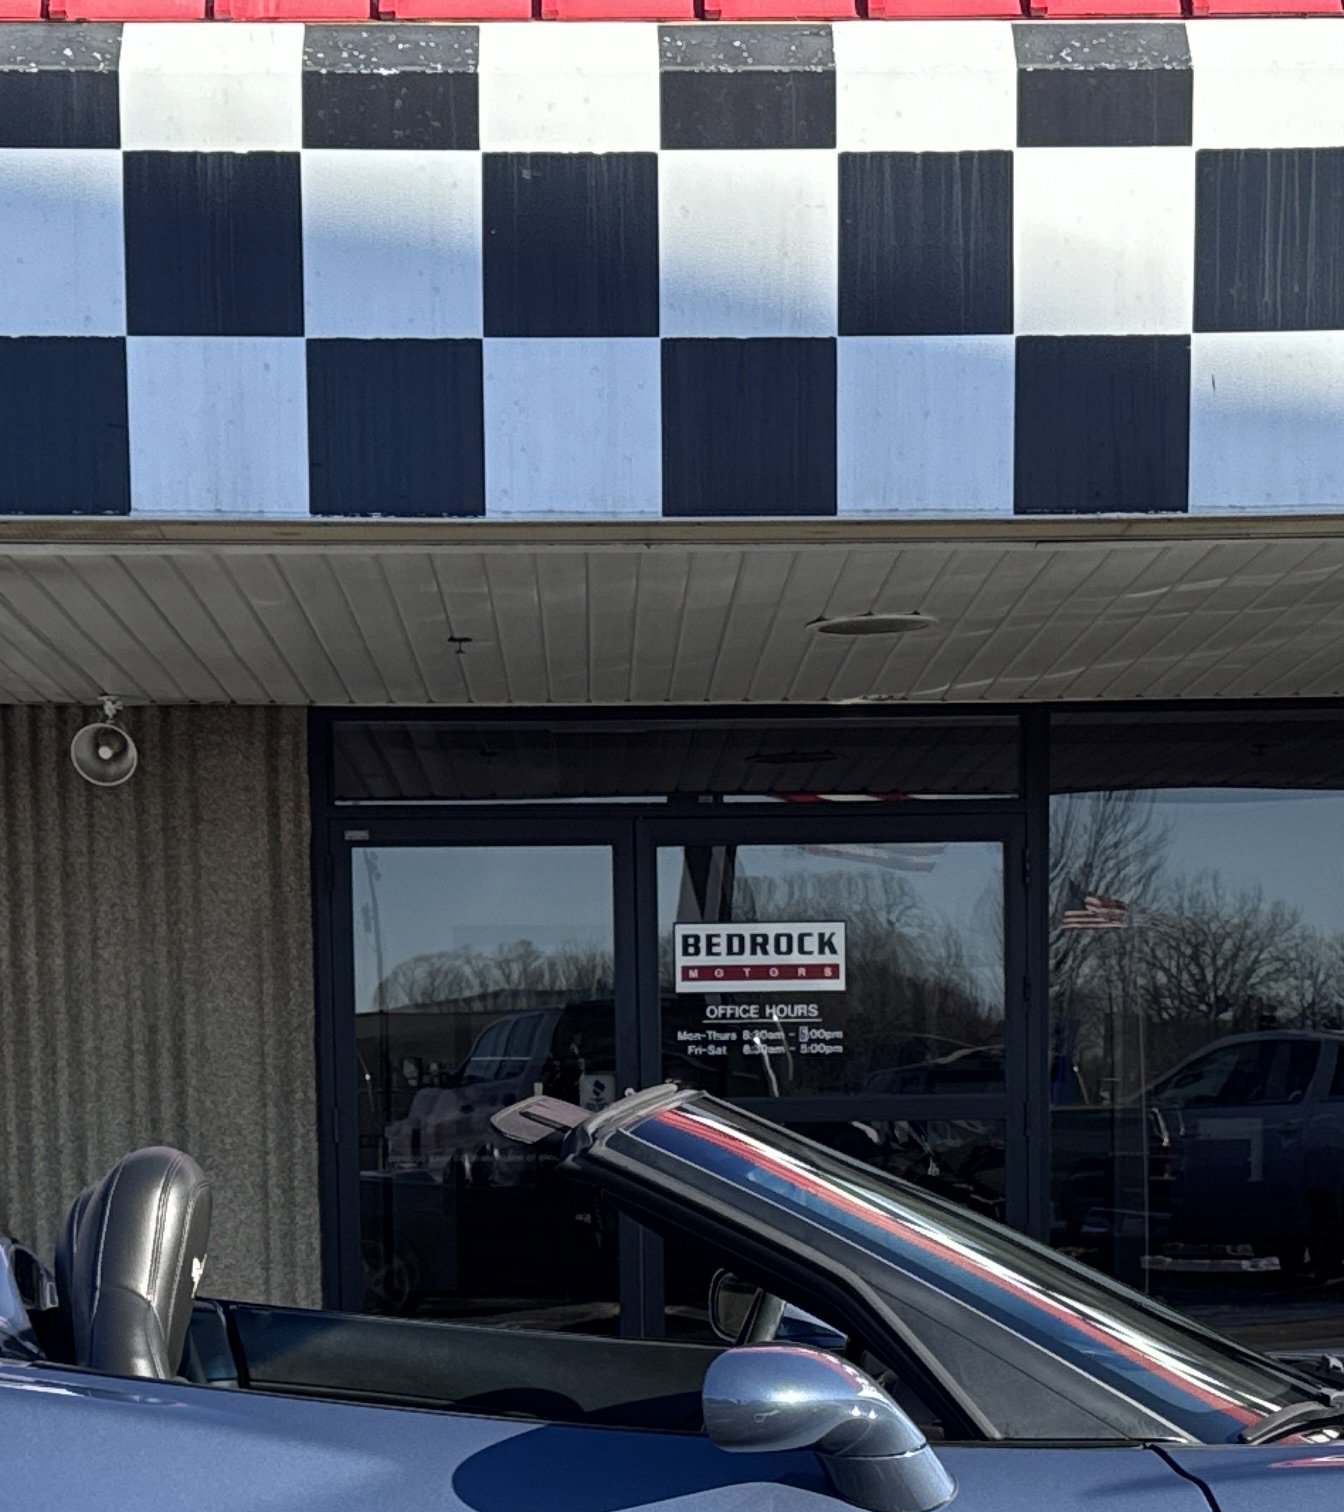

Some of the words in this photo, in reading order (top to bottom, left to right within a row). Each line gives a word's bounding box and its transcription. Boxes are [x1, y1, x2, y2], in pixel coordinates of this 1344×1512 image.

[681, 931, 838, 957] BEDROCK
[688, 966, 833, 979] MOTORS
[706, 1004, 759, 1019] OFFICE
[765, 1003, 819, 1018] HOURS
[687, 1044, 727, 1055] Fri-Sat
